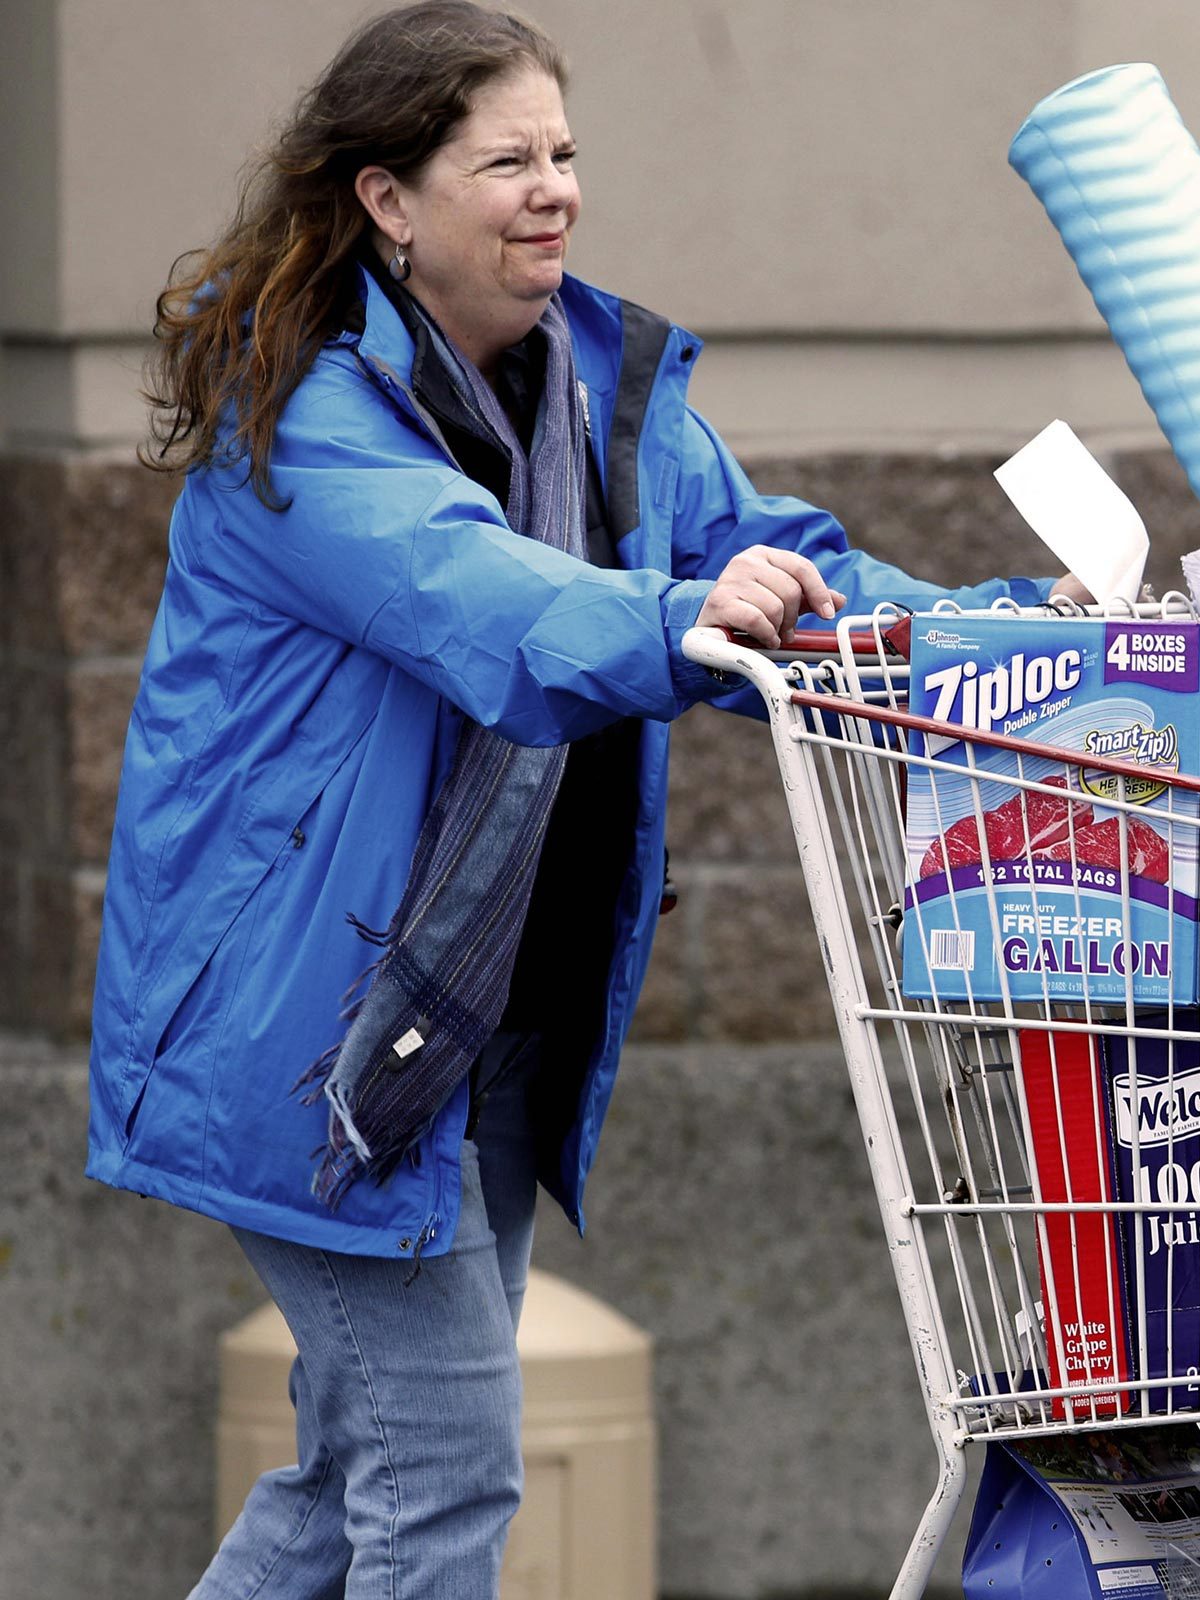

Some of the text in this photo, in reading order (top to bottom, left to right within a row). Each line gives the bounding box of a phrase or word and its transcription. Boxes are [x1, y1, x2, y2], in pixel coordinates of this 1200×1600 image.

[1107, 634, 1130, 671] 4
[1132, 634, 1186, 653] BOXES
[1132, 655, 1186, 673] INSIDE
[925, 649, 1080, 757] Ziploc
[1004, 696, 1072, 736] Double Zipper
[1086, 724, 1140, 754] Smart
[1125, 782, 1157, 794] RESH!
[1013, 865, 1065, 880] TOTAL
[1072, 867, 1116, 887] BAGS
[1003, 904, 1056, 913] HEAVY UTY
[1003, 915, 1122, 937] FREEZER
[1002, 936, 1171, 979] GALLON
[1153, 1128, 1177, 1138] FAMIY
[1178, 1121, 1200, 1132] FARMER
